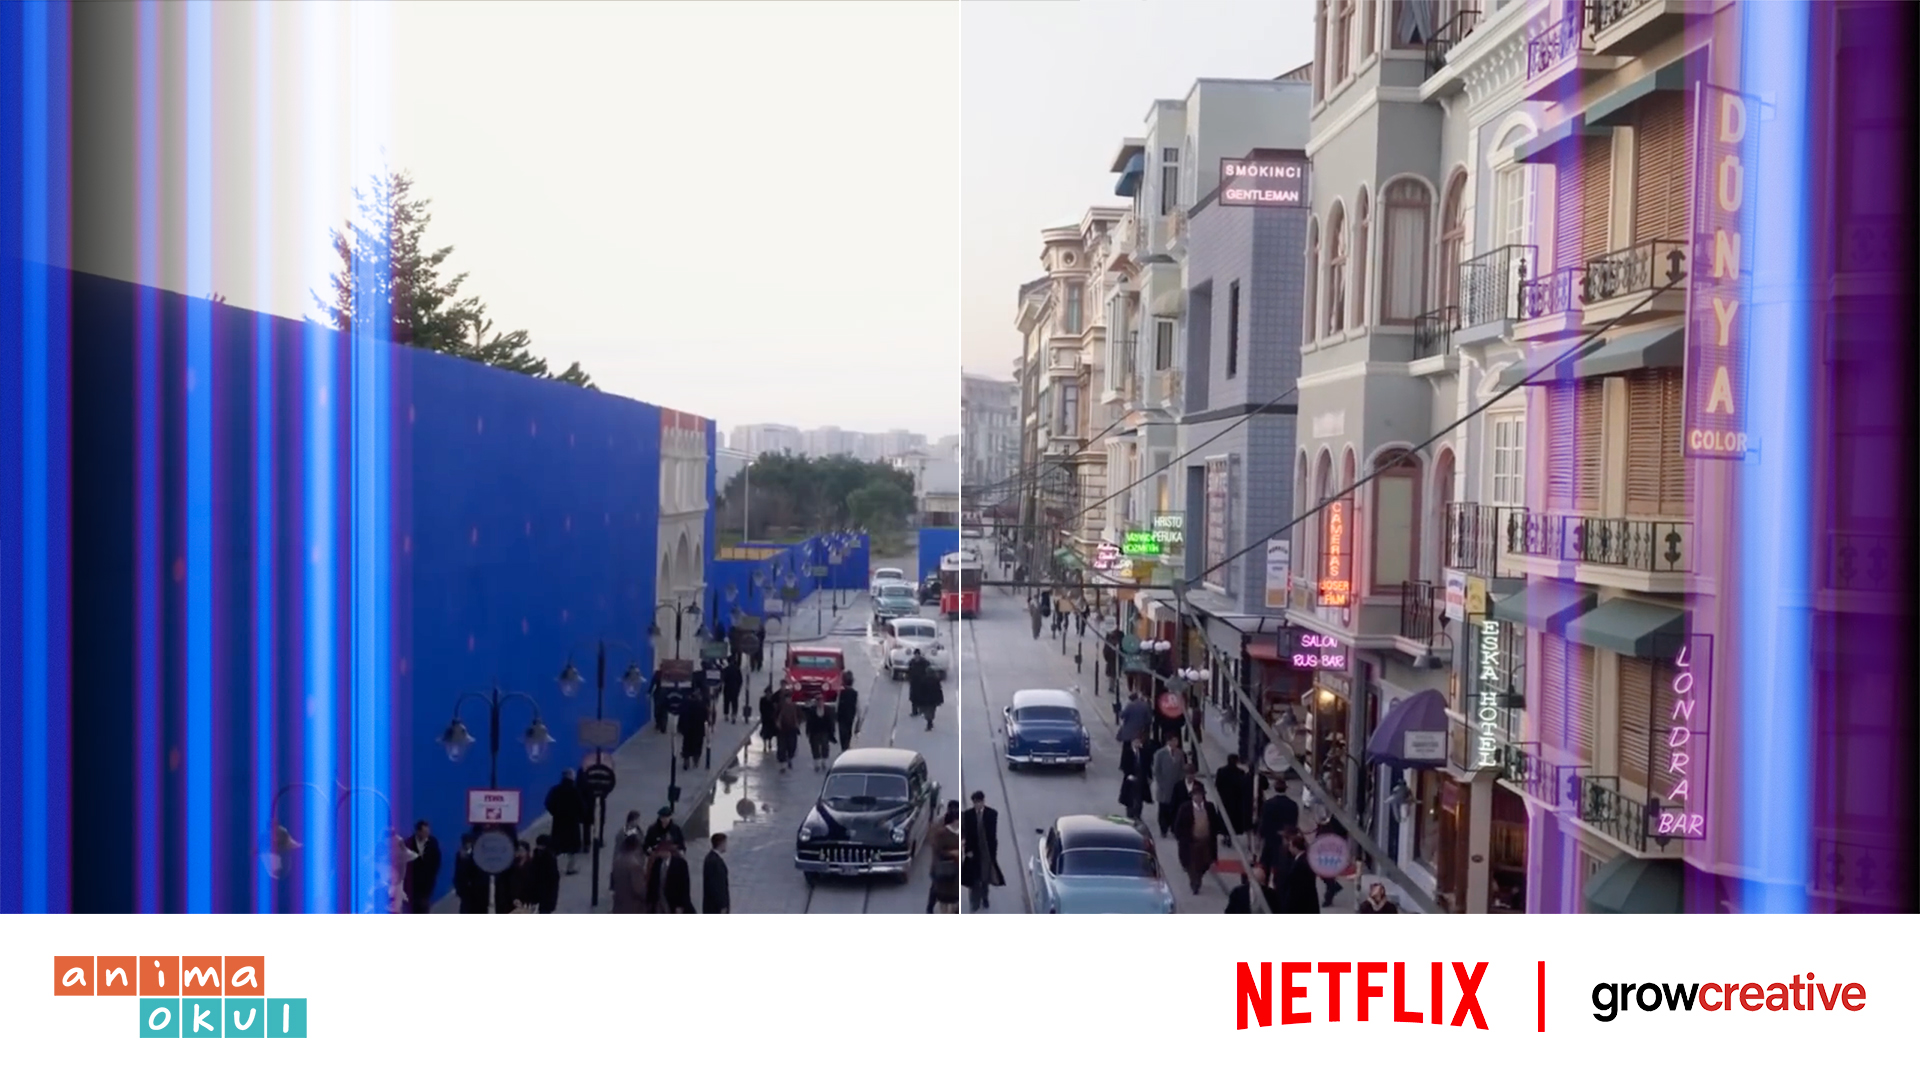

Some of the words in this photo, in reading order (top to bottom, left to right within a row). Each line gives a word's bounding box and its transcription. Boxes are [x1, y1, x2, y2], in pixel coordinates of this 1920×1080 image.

[1225, 188, 1299, 202] GENTLEMAN
[1691, 429, 1748, 452] COLOR
[1154, 516, 1183, 528] HRISTO
[1153, 530, 1184, 543] PERUKA
[1330, 502, 1343, 576] CAMERAS
[1301, 634, 1338, 648] SALON
[1479, 620, 1500, 681] ESKA
[1478, 692, 1498, 767] HOTEL
[1668, 646, 1695, 801] LONDRA
[1658, 812, 1704, 836] BAR
